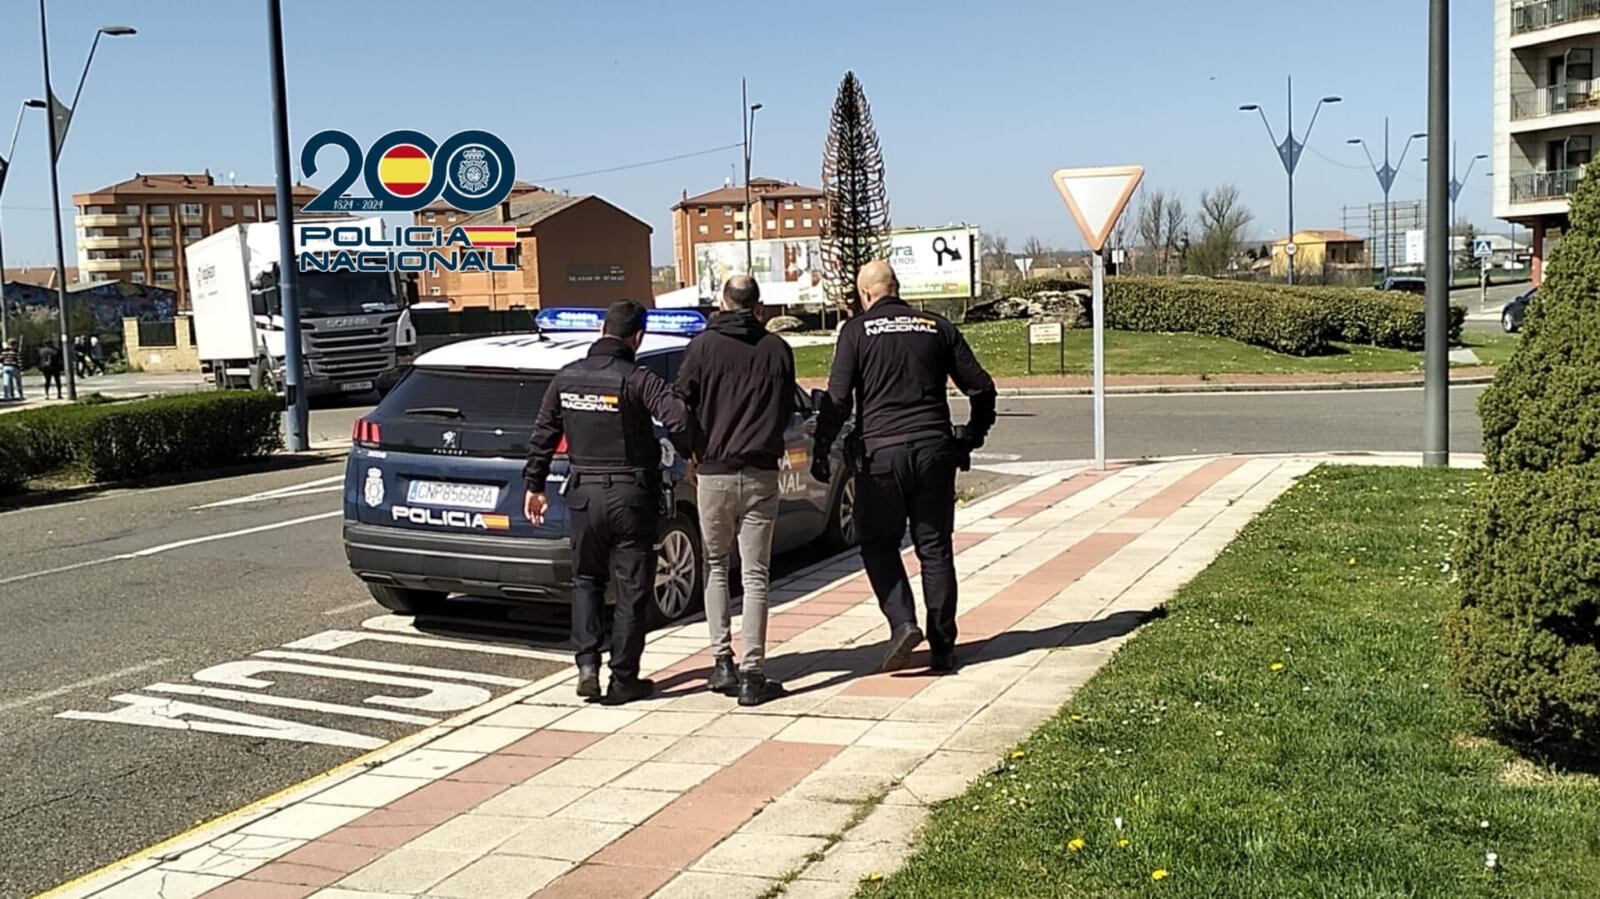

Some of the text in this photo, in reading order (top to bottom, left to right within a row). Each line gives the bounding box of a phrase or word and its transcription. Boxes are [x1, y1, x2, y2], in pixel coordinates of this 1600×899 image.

[864, 316, 920, 329] POLICIA
[865, 323, 938, 337] NACIONAL
[560, 392, 605, 403] POLICIA
[561, 400, 620, 412] NACIONAL
[417, 481, 493, 505] CNP8566BA
[391, 505, 488, 529] POLICIA
